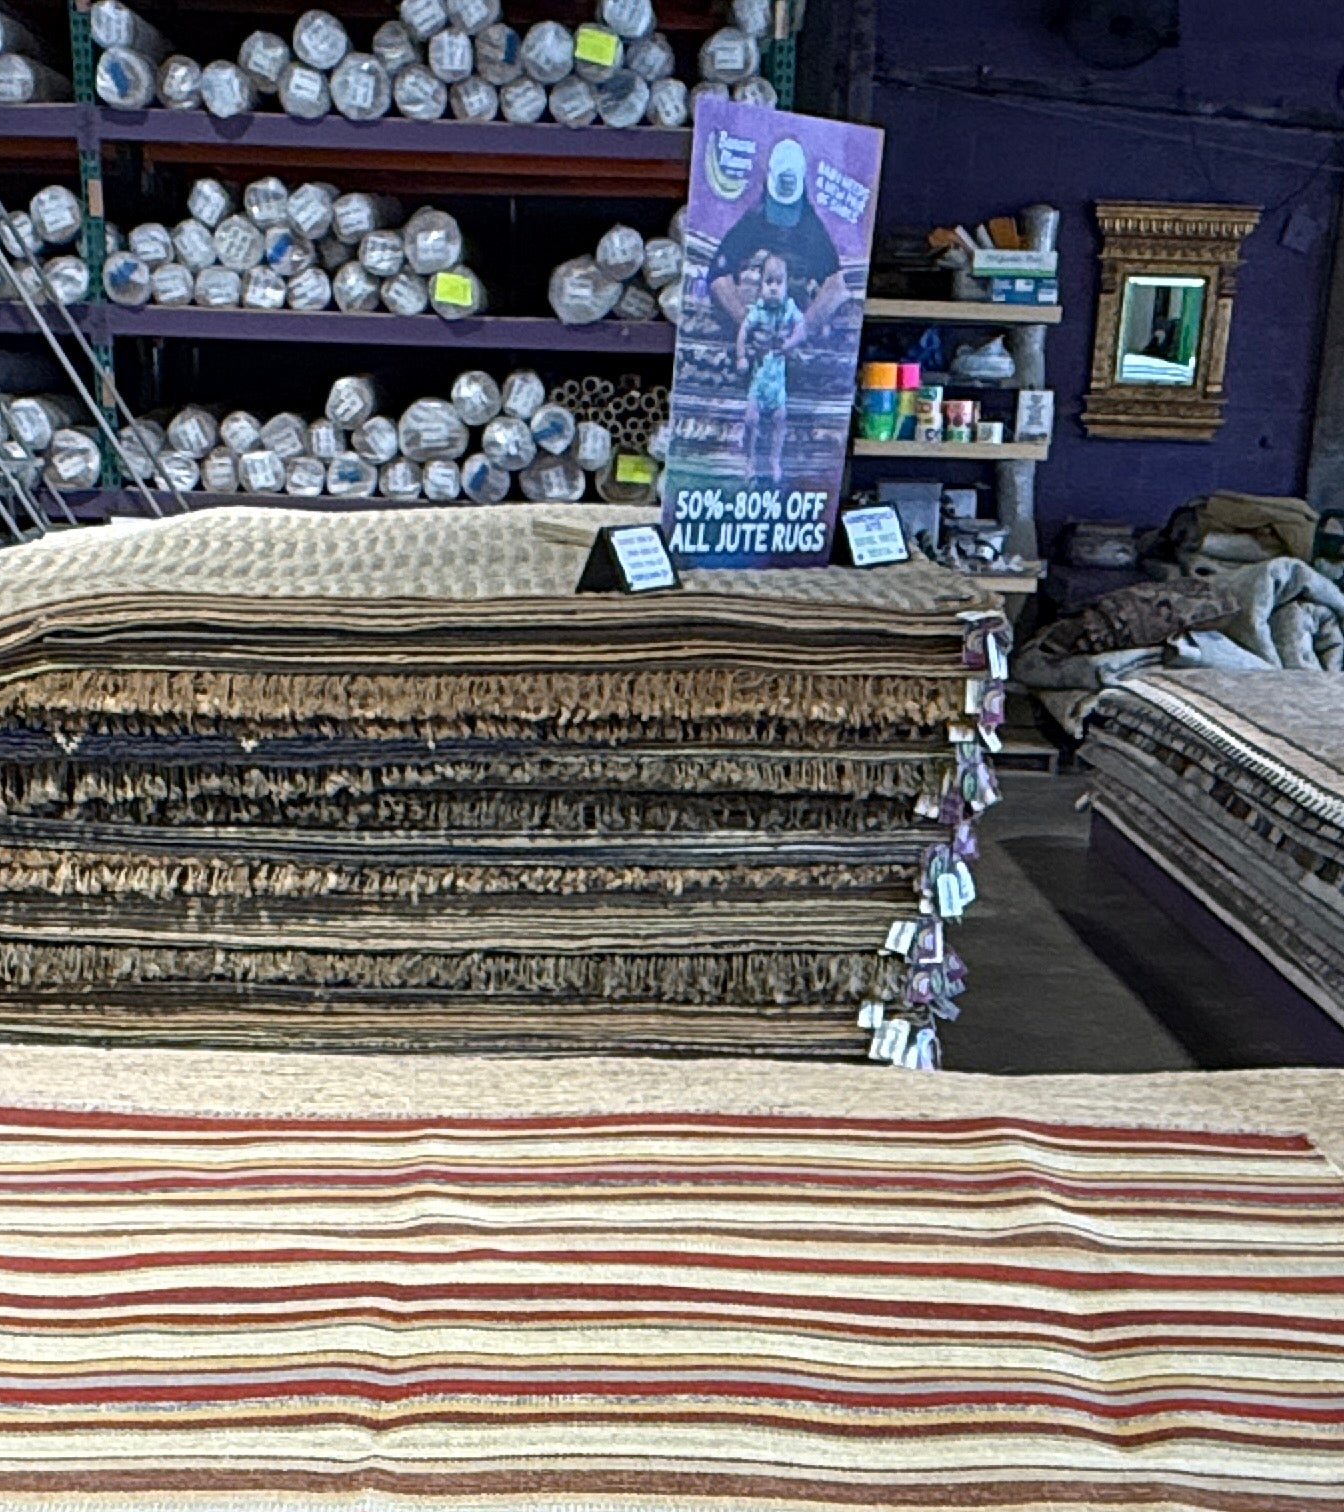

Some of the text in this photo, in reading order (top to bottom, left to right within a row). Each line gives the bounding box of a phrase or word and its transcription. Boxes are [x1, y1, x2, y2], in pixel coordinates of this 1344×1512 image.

[675, 489, 828, 521] 50%-80% OFF
[668, 523, 710, 552] ALL
[715, 523, 770, 552] JUTE
[771, 523, 826, 552] RUGS
